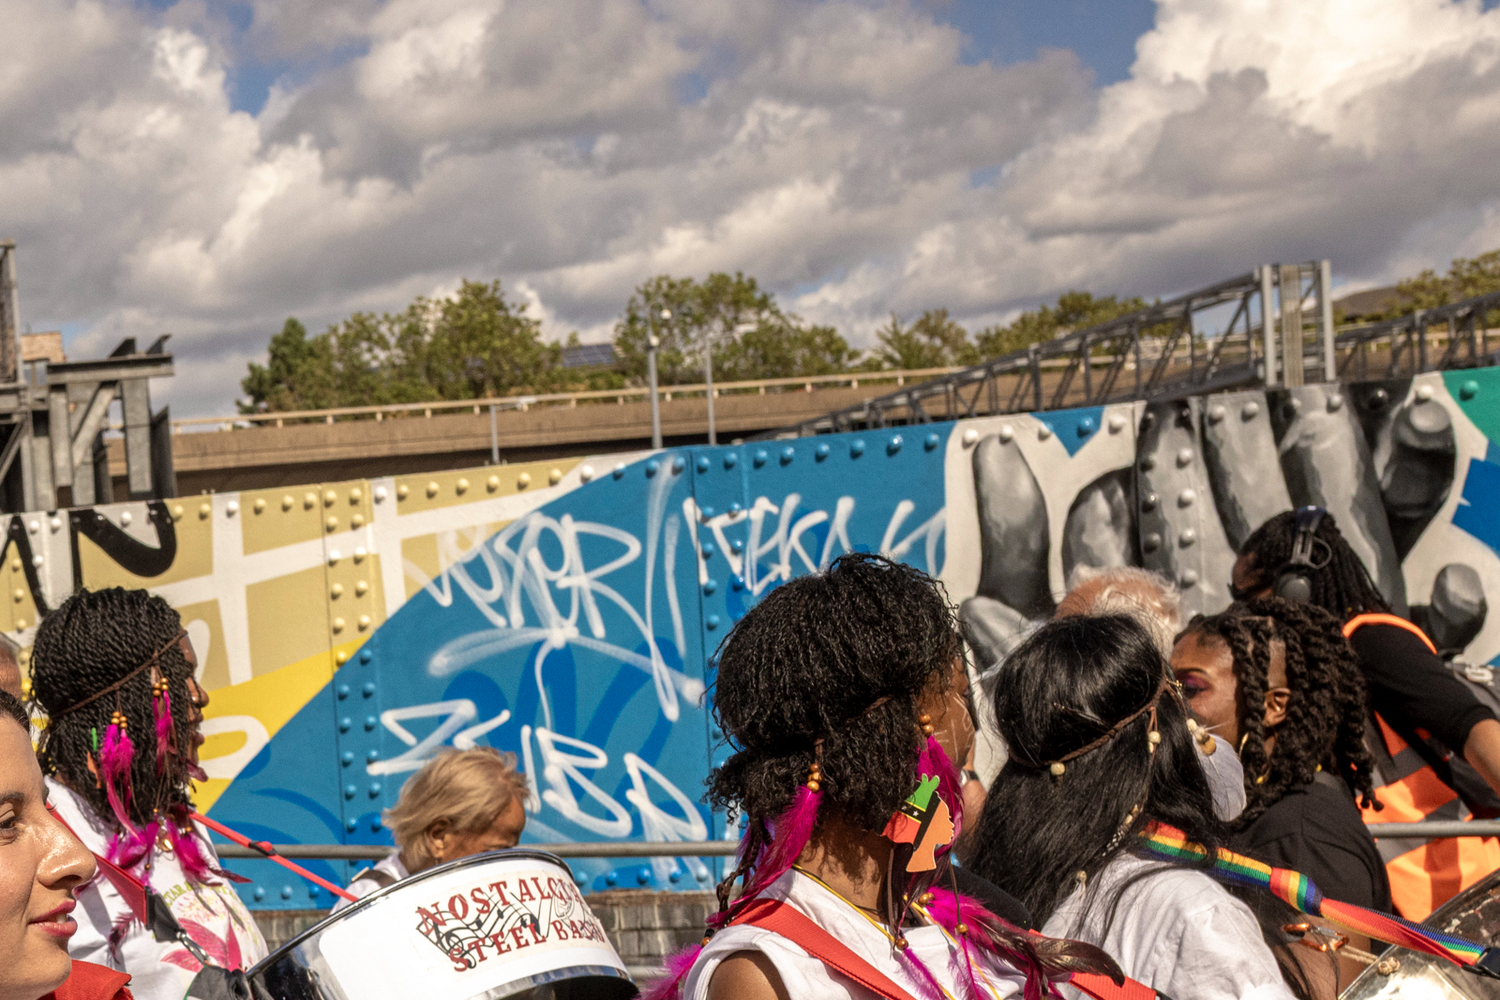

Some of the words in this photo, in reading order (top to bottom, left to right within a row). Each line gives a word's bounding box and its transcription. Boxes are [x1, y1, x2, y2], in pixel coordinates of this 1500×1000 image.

[414, 876, 584, 936] NOSTALGIA
[448, 922, 548, 973] STEEL
[552, 917, 606, 943] BAND
